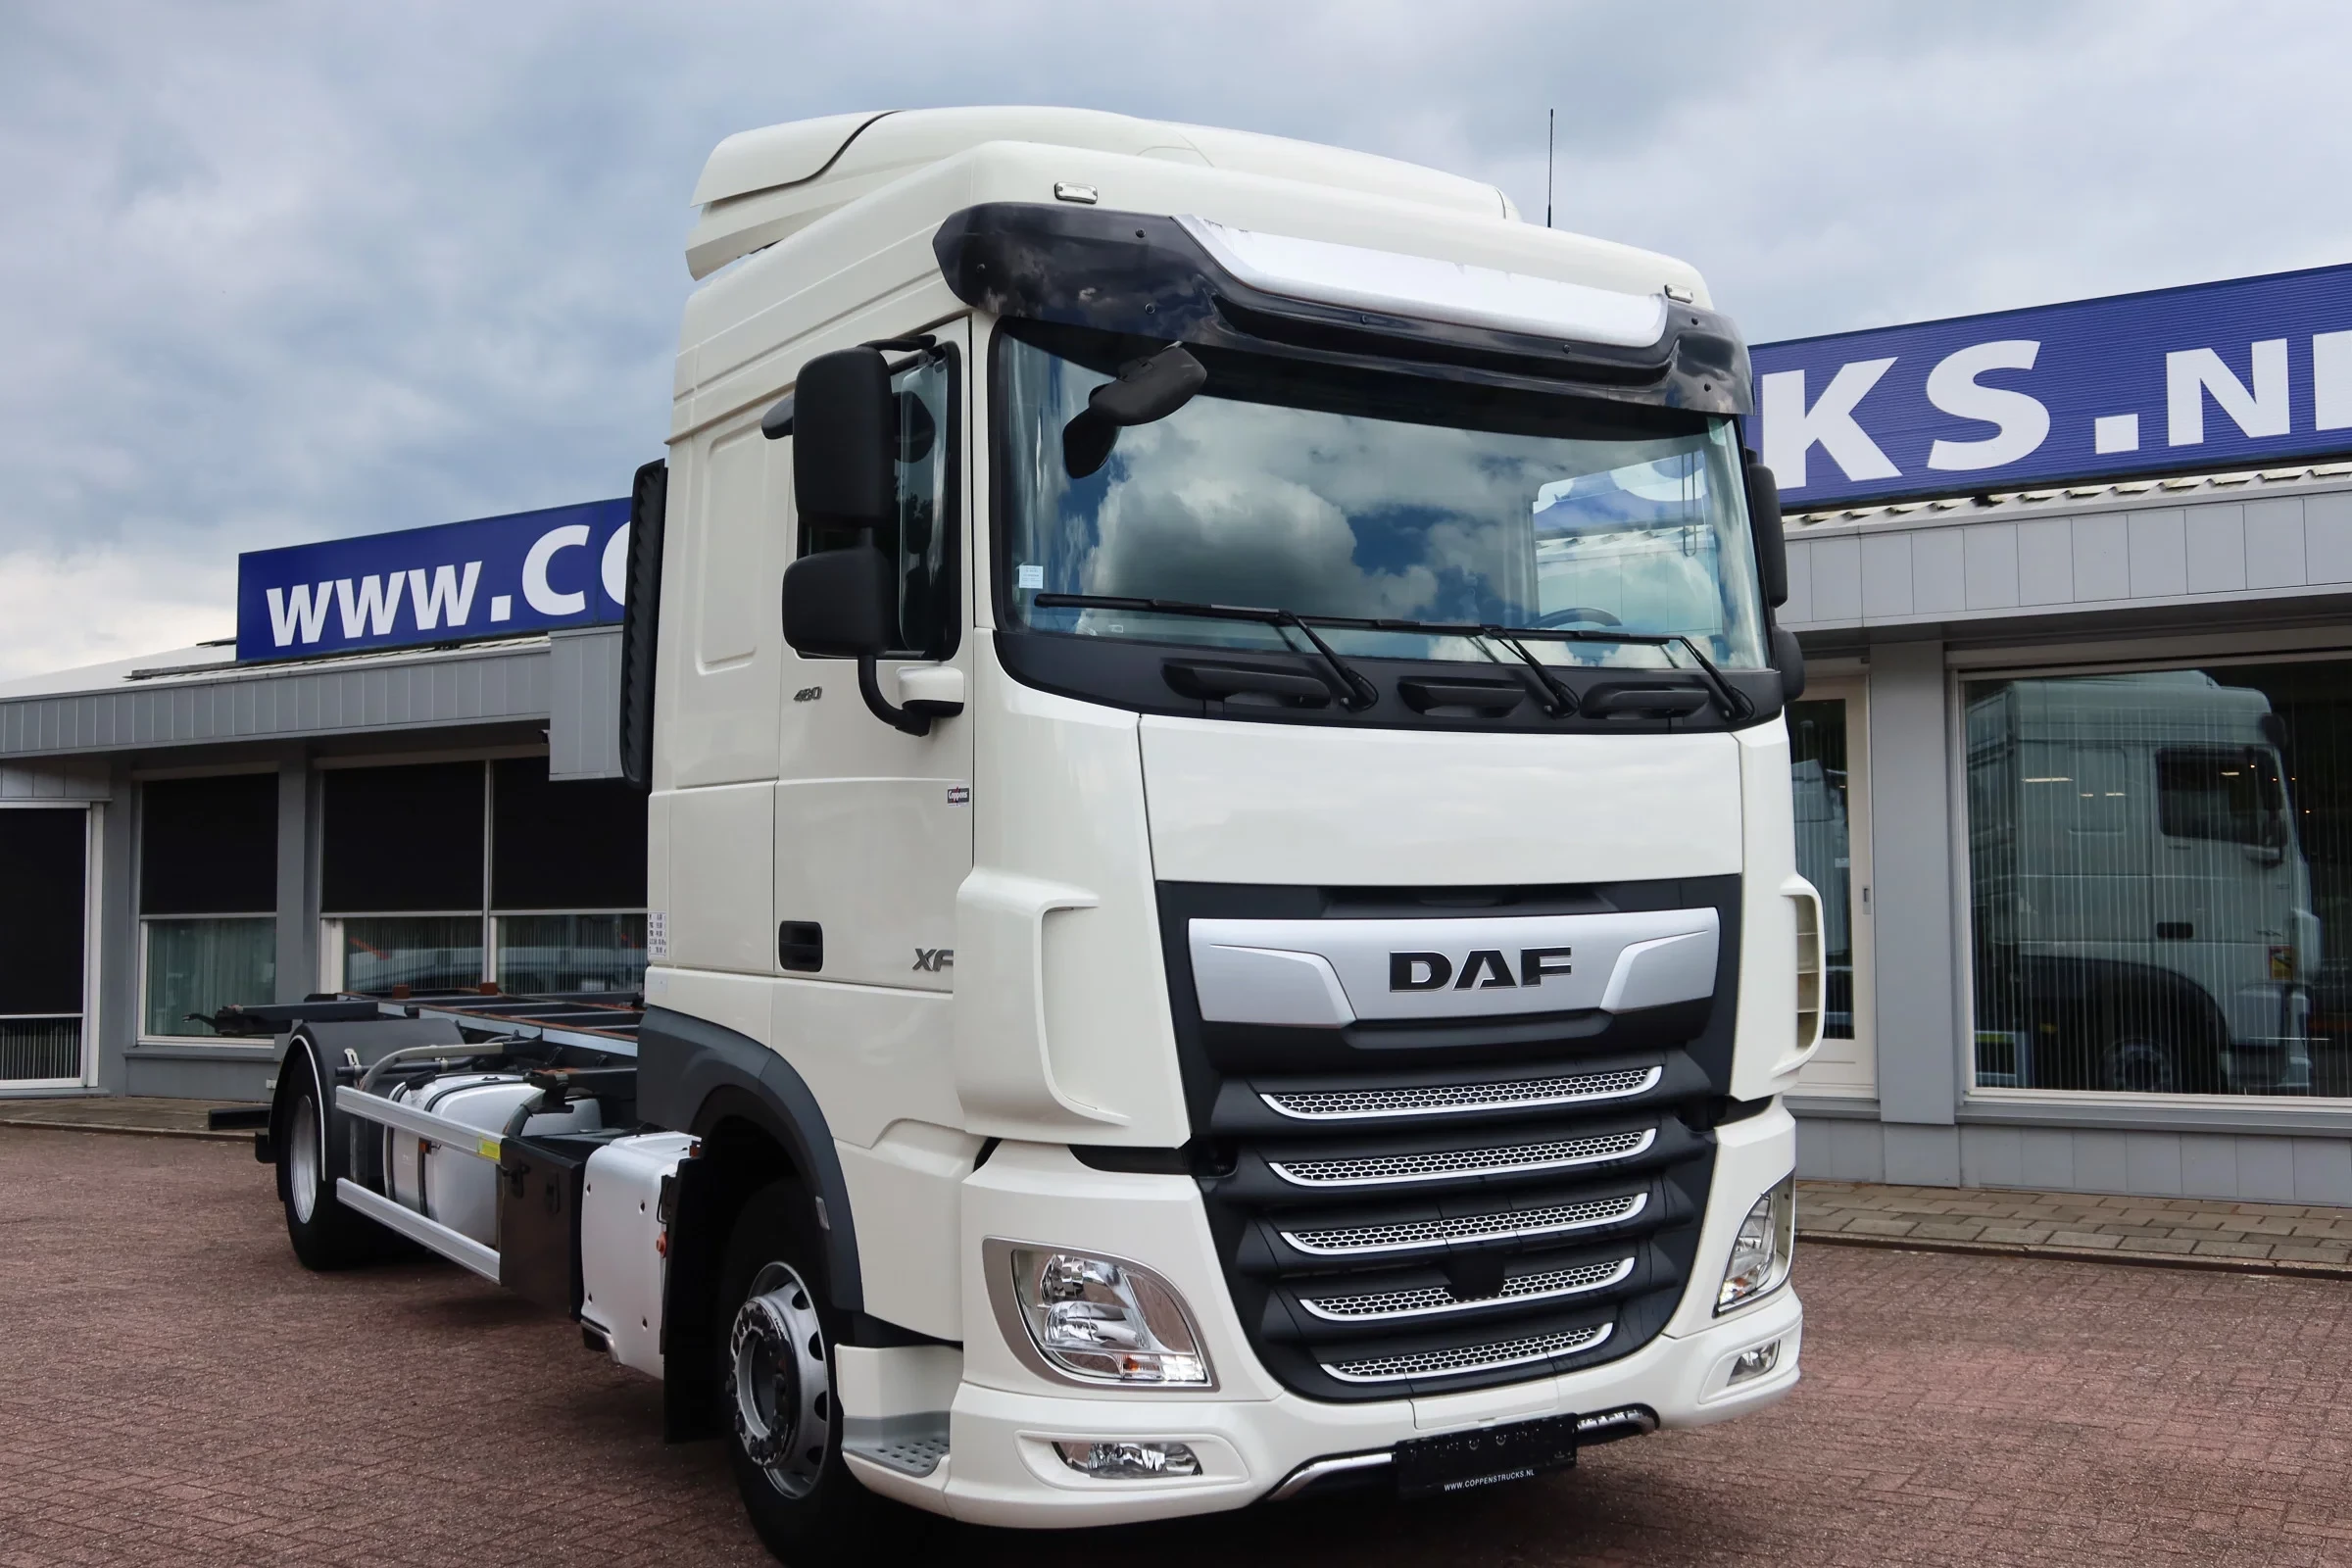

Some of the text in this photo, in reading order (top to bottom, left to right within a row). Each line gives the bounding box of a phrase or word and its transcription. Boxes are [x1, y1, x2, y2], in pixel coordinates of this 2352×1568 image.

[912, 948, 954, 972] XF
[1390, 946, 1572, 993] DAF
[1444, 1469, 1535, 1492] WWW.COPPENSTRUCKS.NL
